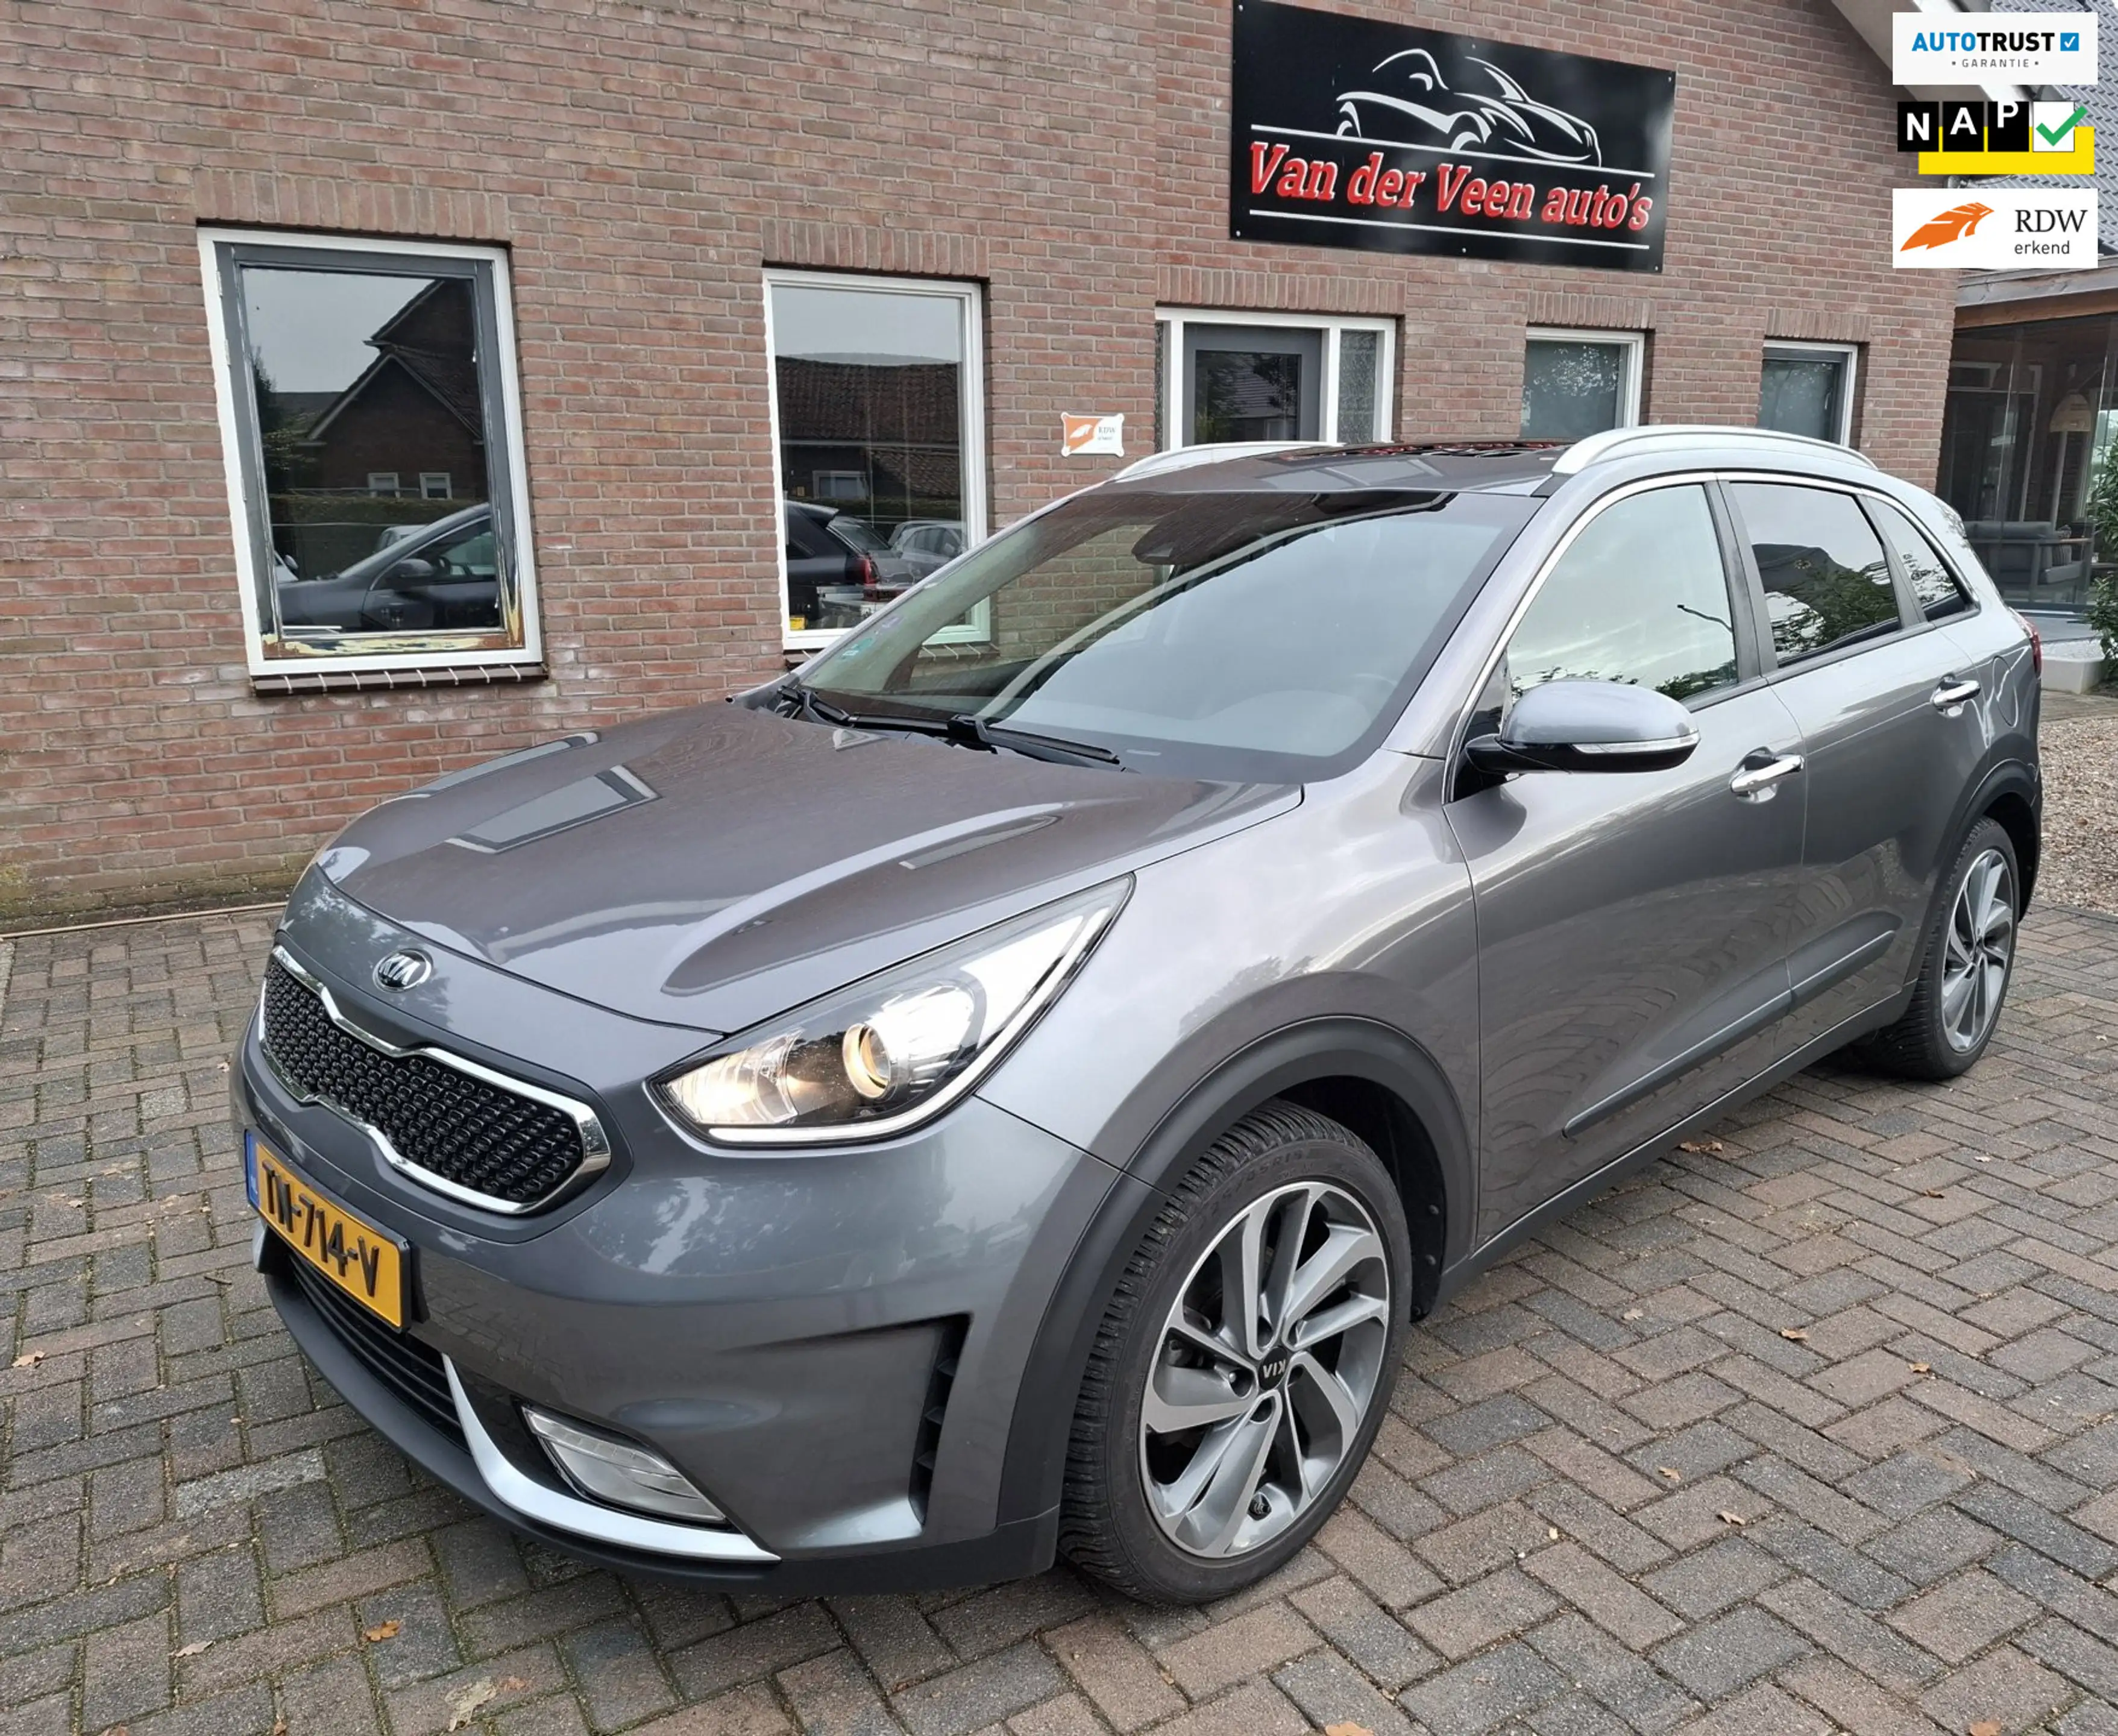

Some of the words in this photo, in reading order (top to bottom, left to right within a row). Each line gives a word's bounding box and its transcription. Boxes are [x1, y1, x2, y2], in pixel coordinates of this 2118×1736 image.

[1249, 141, 1336, 201] Van
[1347, 151, 1427, 210] der
[1436, 163, 1535, 219] Veen
[1541, 182, 1654, 231] auto's
